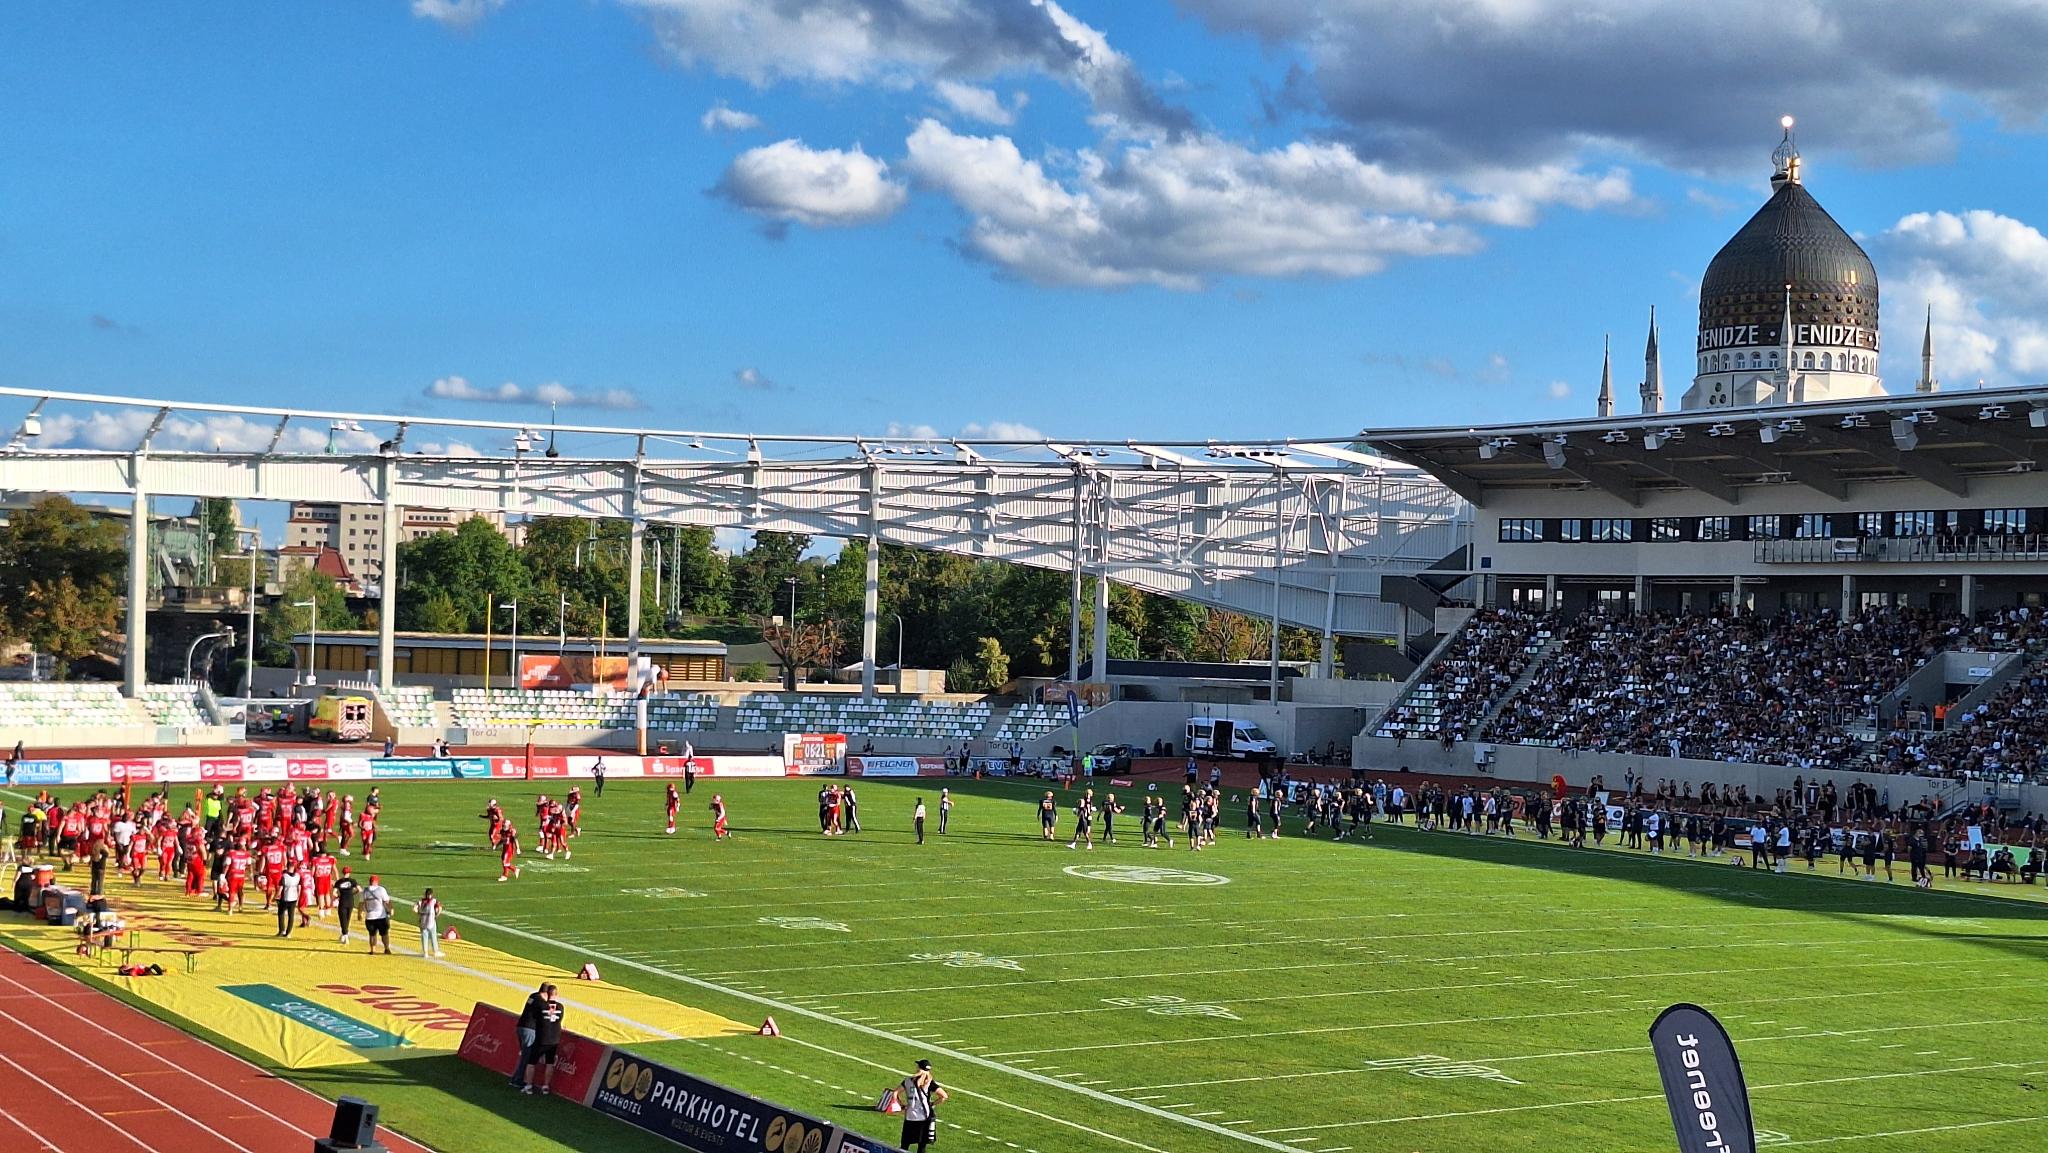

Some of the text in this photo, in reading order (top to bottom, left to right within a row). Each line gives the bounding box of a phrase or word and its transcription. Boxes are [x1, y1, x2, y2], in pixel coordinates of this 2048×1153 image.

[988, 741, 1001, 750] Tor
[875, 760, 914, 768] FELGNER
[987, 760, 1025, 770] EVET
[515, 766, 558, 775] Spkasse
[1927, 779, 1940, 788] Tor
[1364, 1053, 1503, 1080] 10
[597, 1090, 642, 1116] PARKHOTEL
[649, 1081, 761, 1144] PARKHOTEL
